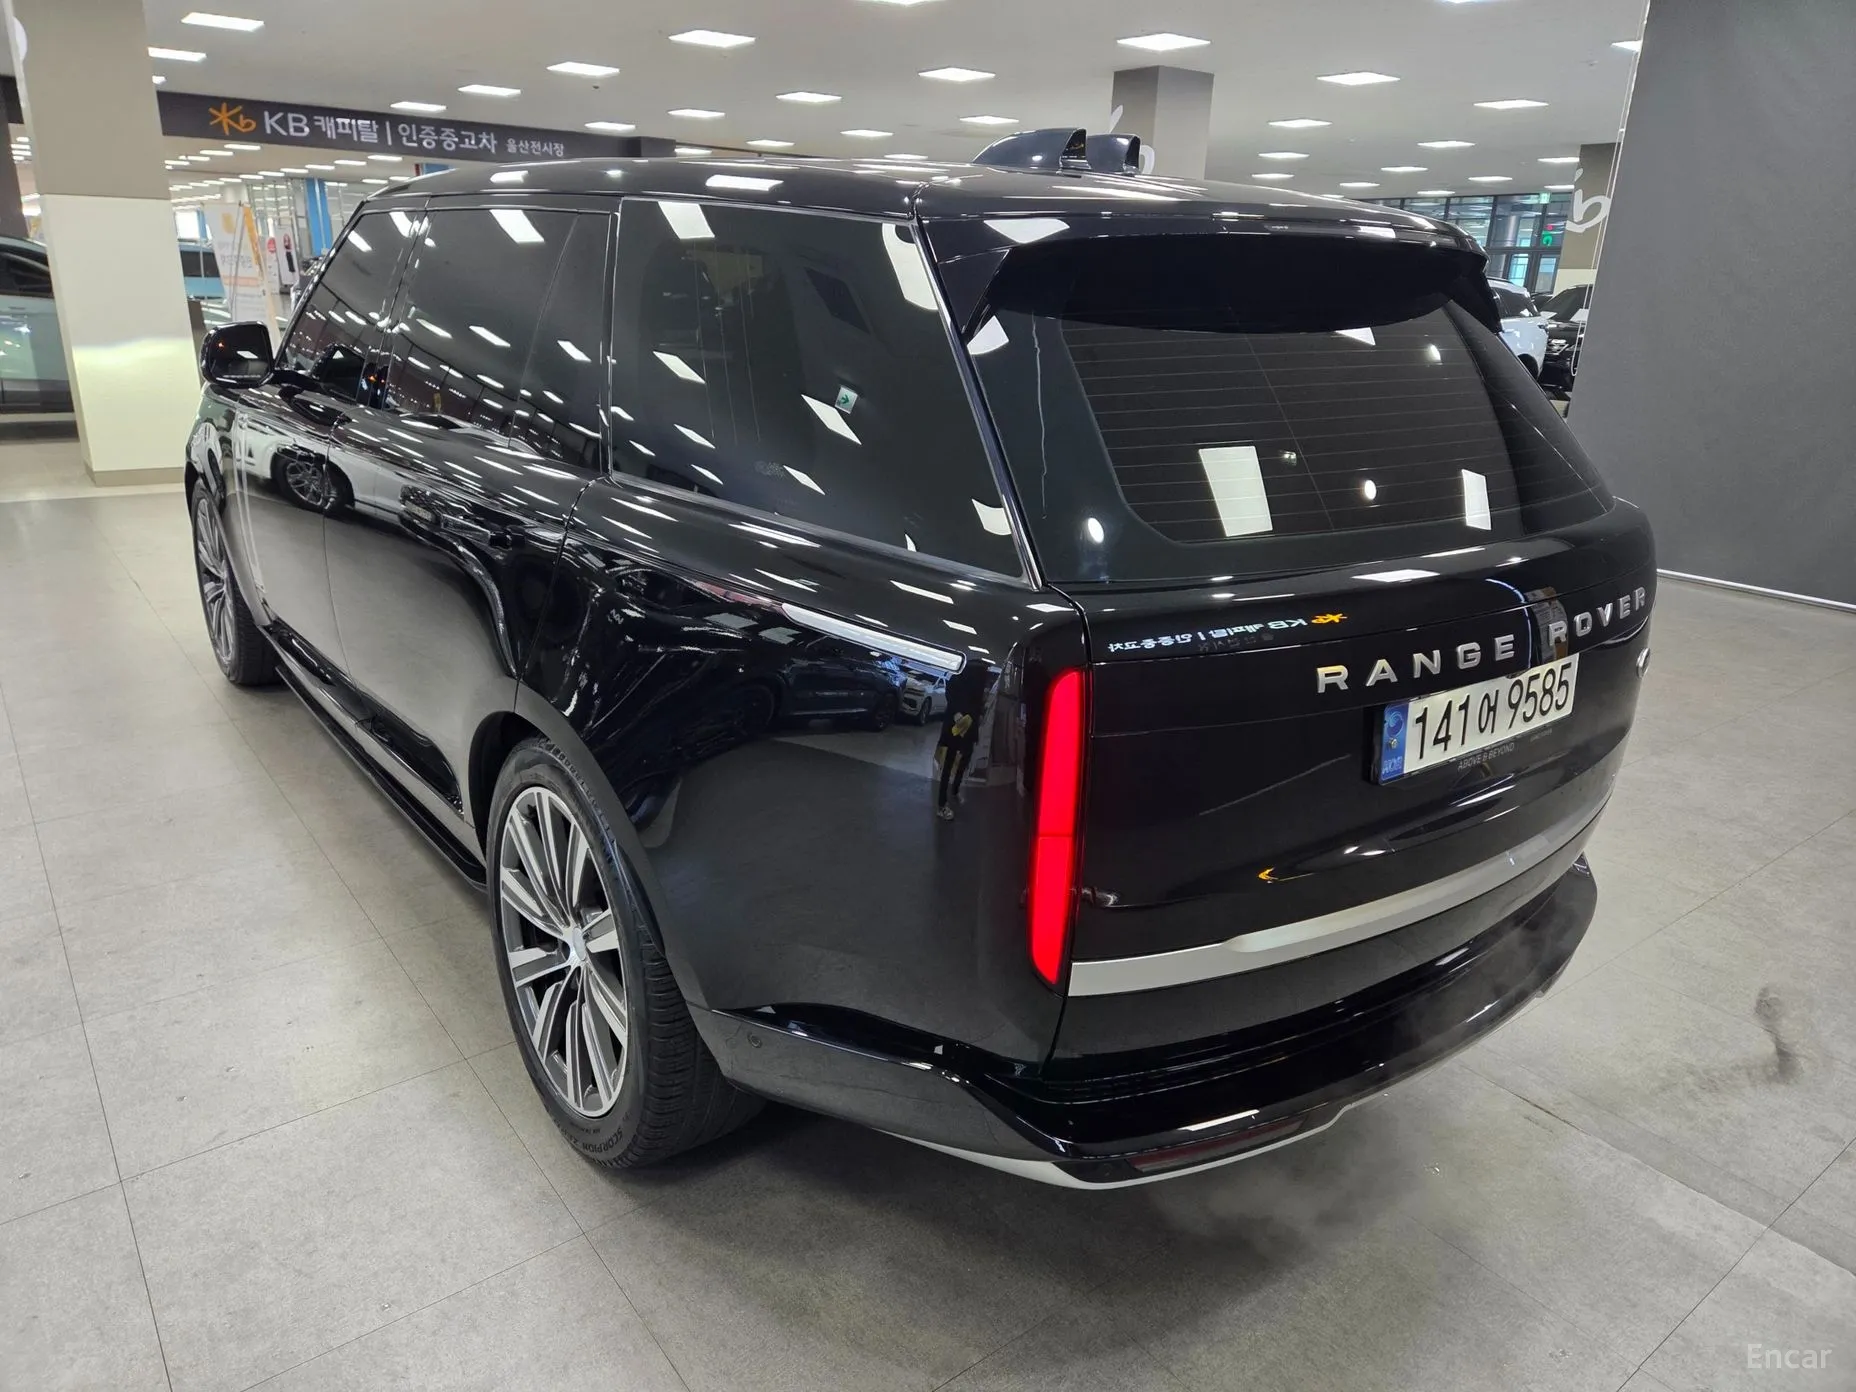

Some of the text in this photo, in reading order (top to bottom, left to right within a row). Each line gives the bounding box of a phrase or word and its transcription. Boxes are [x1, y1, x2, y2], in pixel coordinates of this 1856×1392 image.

[264, 110, 311, 137] KB
[313, 115, 380, 144] 캐피탈
[397, 123, 499, 154] 인증중고차
[506, 138, 564, 157] 울산전시장
[1316, 586, 1646, 693] RANGE ROVER
[1415, 662, 1572, 760] 141어 9585
[1457, 754, 1482, 772] ABOVE
[1488, 742, 1515, 759] BEYOND
[582, 1127, 623, 1154] SCORPION
